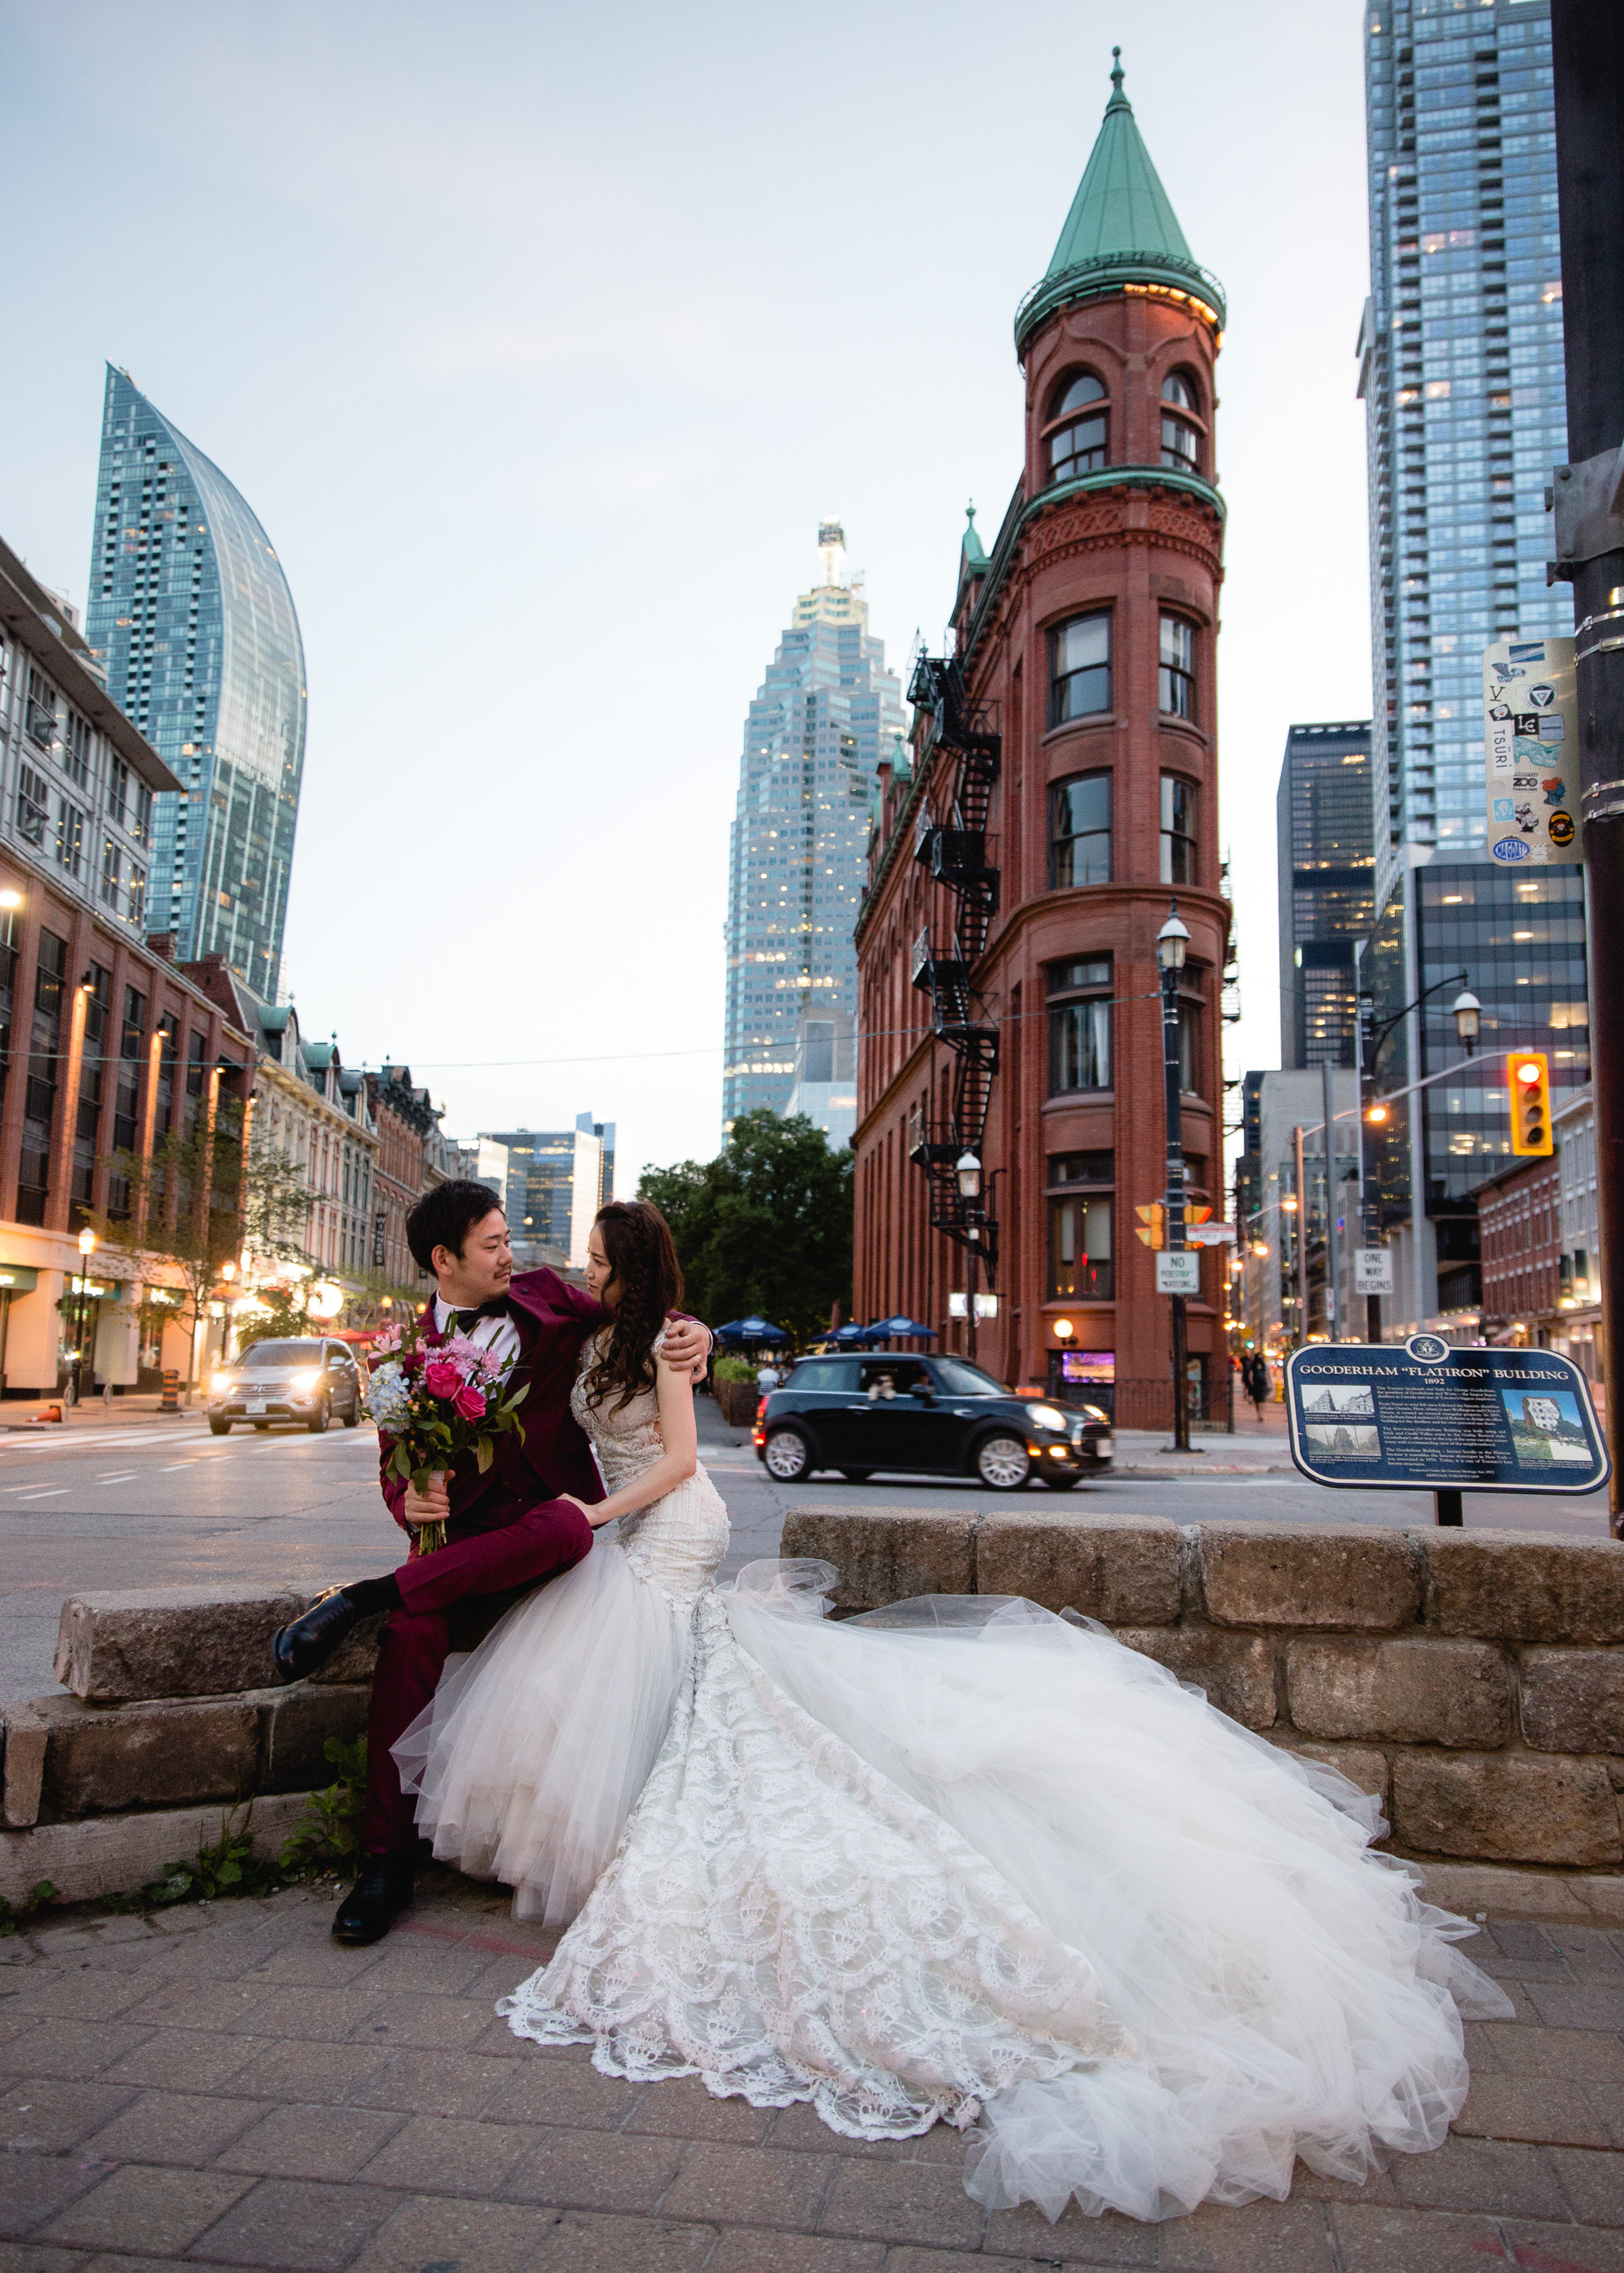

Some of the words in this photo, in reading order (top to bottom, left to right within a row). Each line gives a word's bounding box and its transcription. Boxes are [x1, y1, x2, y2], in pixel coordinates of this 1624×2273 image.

[1513, 777, 1538, 787] ZOO
[1171, 1256, 1185, 1268] NO
[1364, 1254, 1382, 1263] ONE
[1365, 1267, 1383, 1277] WAY
[1358, 1280, 1391, 1291] BEGINS
[1300, 1365, 1398, 1375] GOODERHAM
[1493, 1369, 1569, 1380] BUILDING
